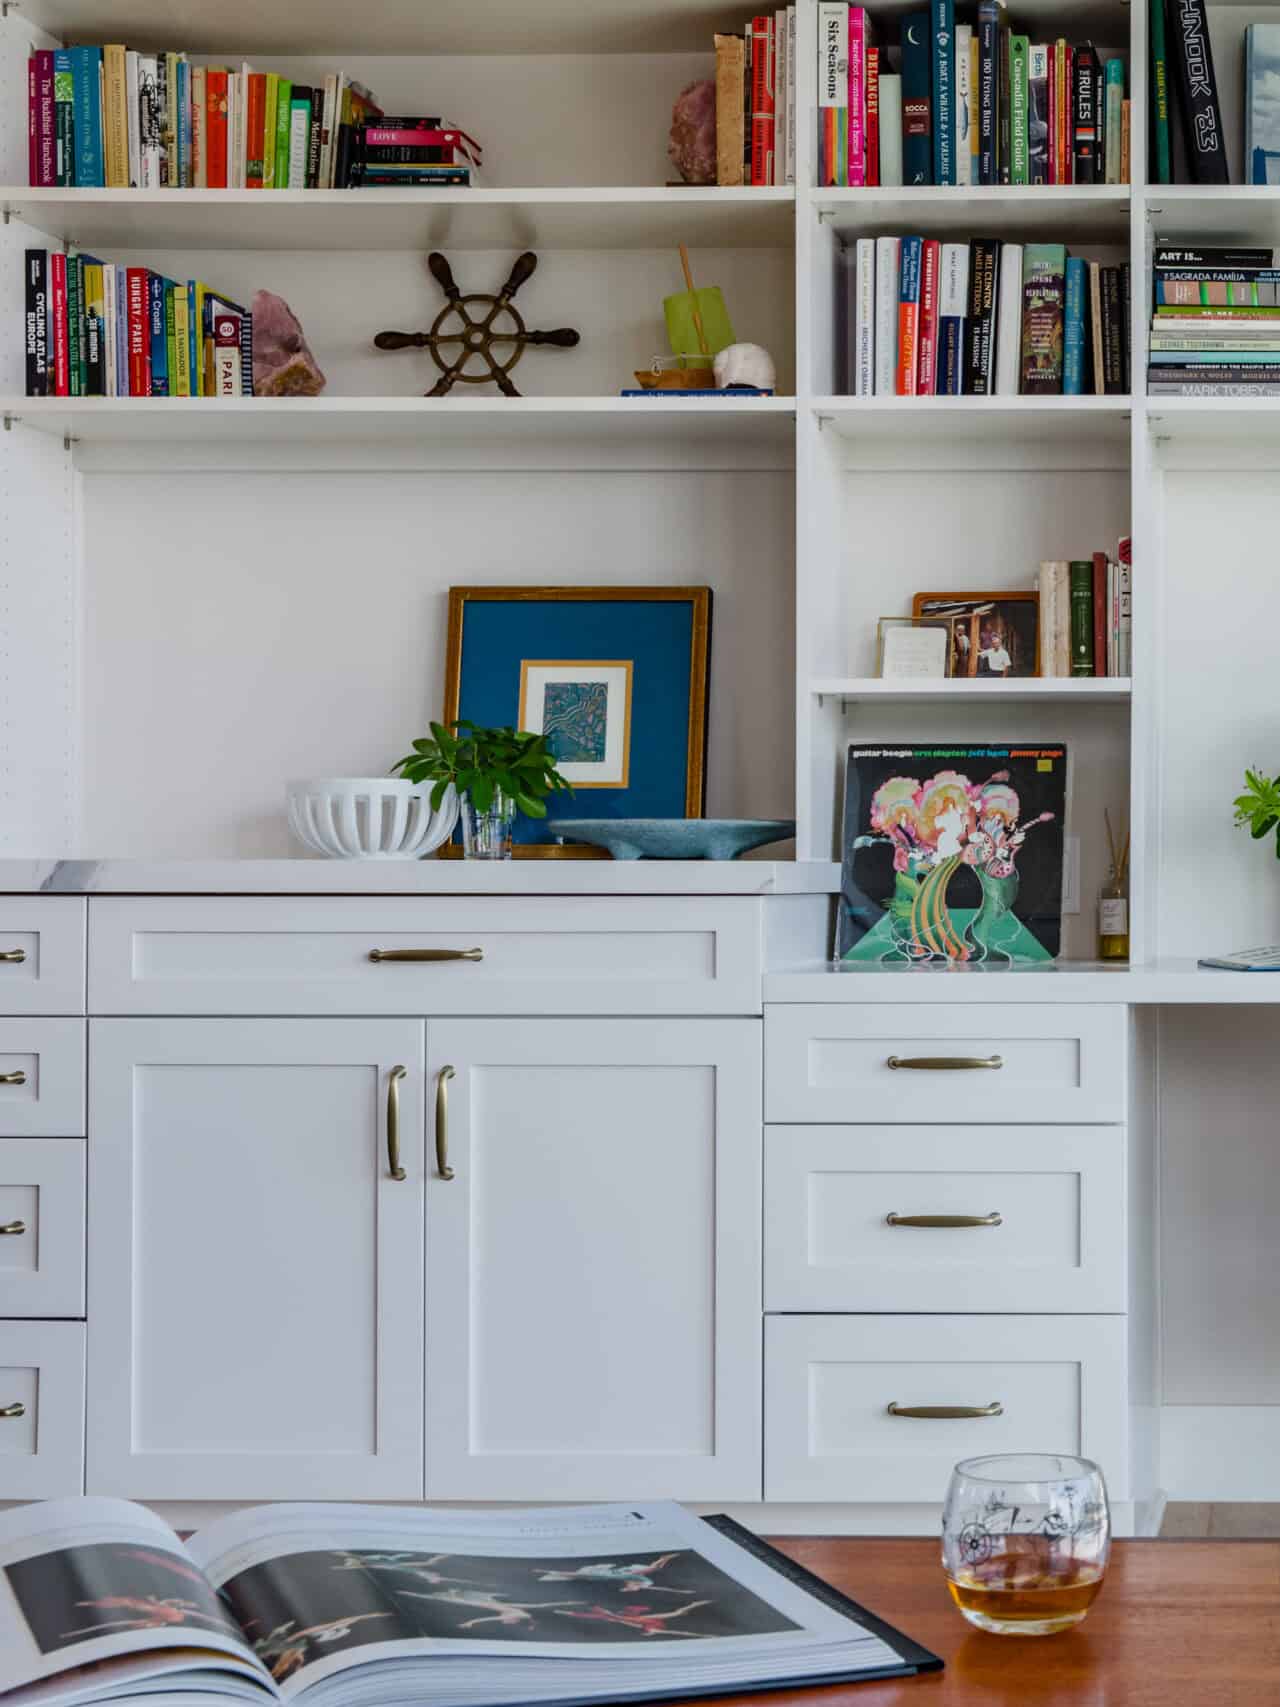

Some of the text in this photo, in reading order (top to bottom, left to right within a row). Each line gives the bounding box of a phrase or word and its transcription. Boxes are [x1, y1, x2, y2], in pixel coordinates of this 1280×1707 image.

[827, 20, 840, 100] Six Seasons
[852, 40, 862, 76] barefoot
[983, 58, 992, 74] 100
[41, 80, 51, 95] The
[852, 78, 860, 118] contessa
[867, 53, 878, 115] DELANCEY
[1079, 76, 1092, 120] RULES
[41, 97, 51, 135] Buddhist
[904, 104, 928, 113] BOCCA
[939, 93, 949, 121] WHALE
[1014, 57, 1025, 172] Cascadia Field Guide
[310, 121, 321, 174] Meditation
[372, 131, 397, 142] LOVE
[42, 138, 52, 183] Handbook
[1159, 252, 1181, 261] ART
[974, 247, 984, 315] JAMES PATTERSON
[983, 255, 993, 309] BILL CLINTON
[1170, 272, 1210, 281] SAGRADA
[131, 276, 141, 315] HUNGRY
[27, 311, 36, 354] EUROPE
[36, 291, 45, 373] CYCLING ATLAS
[153, 300, 162, 335] Croatia
[222, 326, 233, 334] 50
[89, 318, 98, 363] SEE AMERICA
[132, 323, 142, 354] PARIS
[904, 335, 913, 368] GUTSY
[972, 336, 981, 367] MISSING
[980, 319, 991, 376] THE PRESIDENT
[222, 360, 233, 395] PARI
[1181, 384, 1265, 394] MARK TOBEY
[852, 750, 881, 759] guitar
[882, 750, 913, 759] boogie
